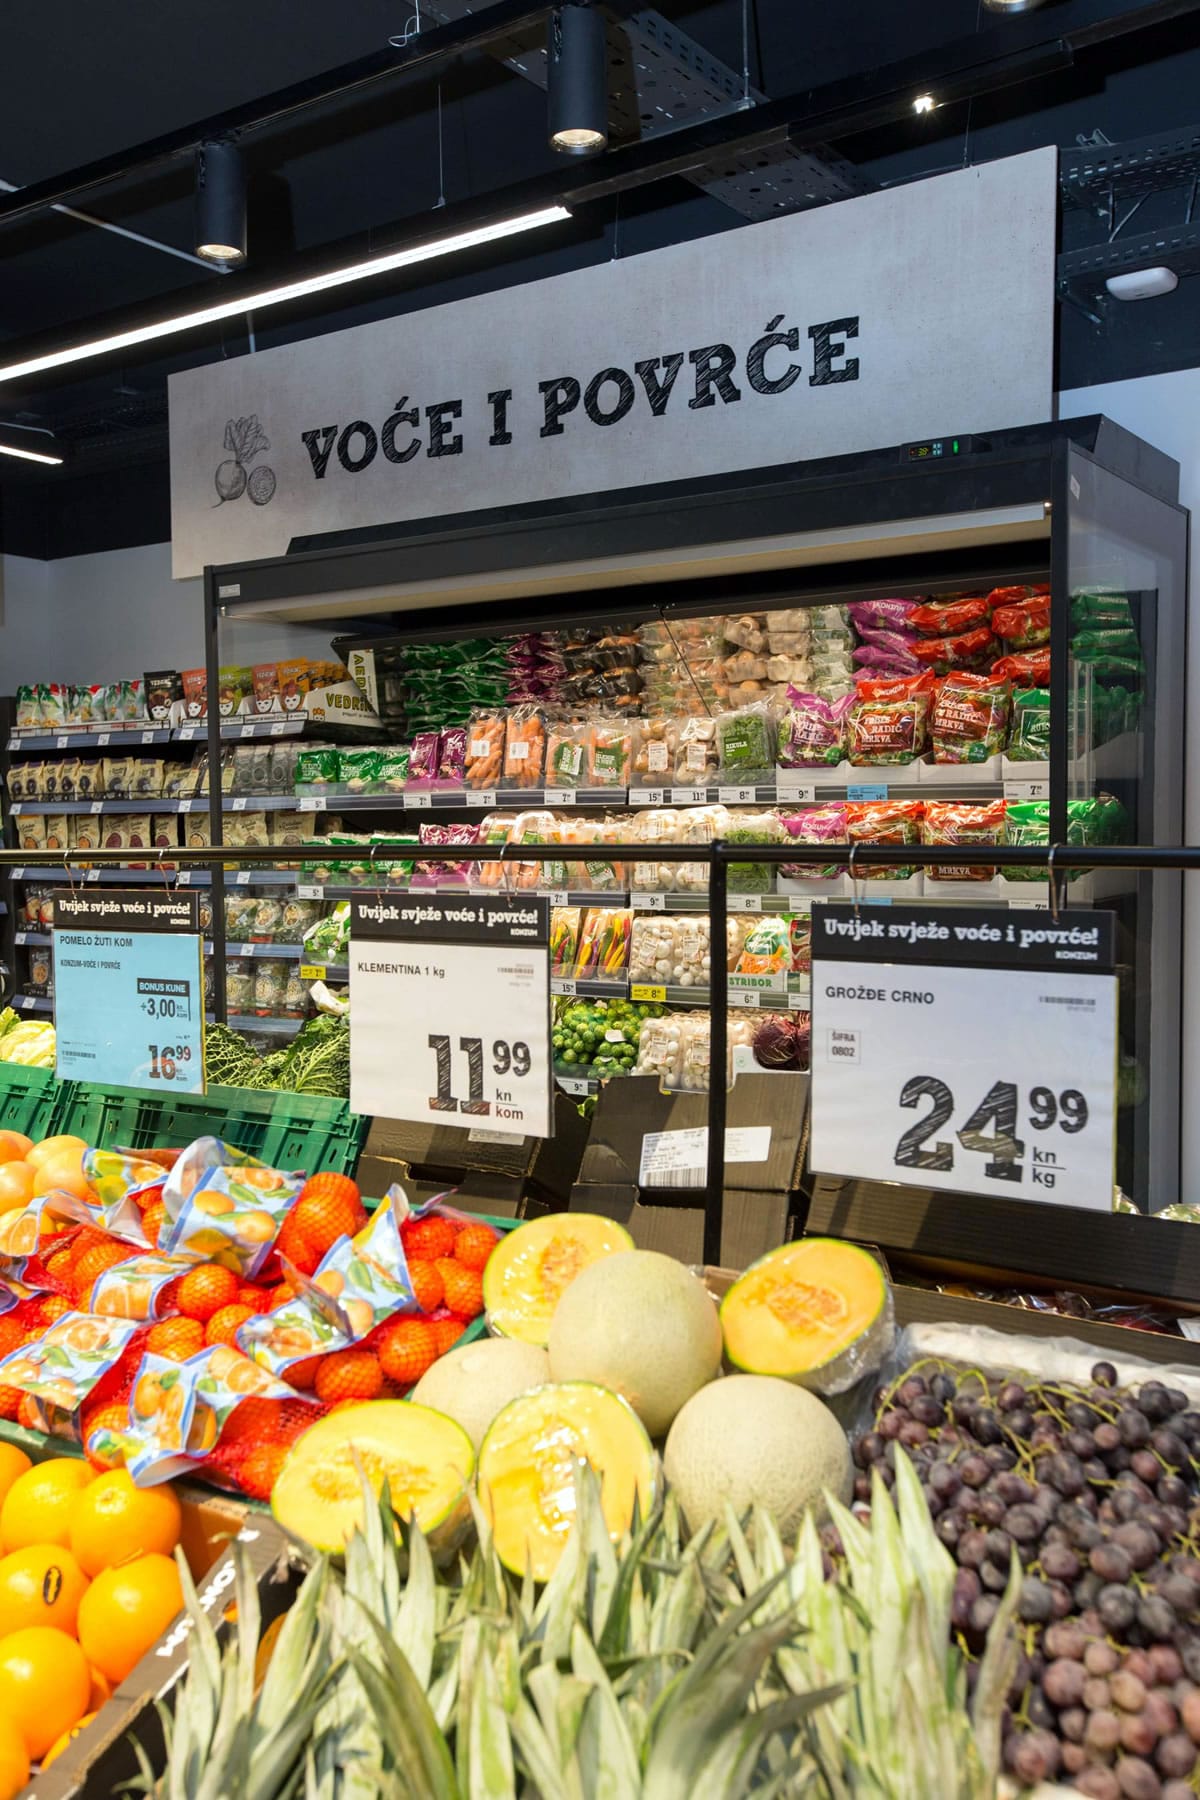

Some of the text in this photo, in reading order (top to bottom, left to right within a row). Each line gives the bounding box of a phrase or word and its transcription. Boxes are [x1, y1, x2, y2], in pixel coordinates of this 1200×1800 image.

[302, 314, 861, 480] VOĆE I POVRĆE
[935, 717, 965, 731] MRKVA
[861, 734, 892, 743] MRKVA
[938, 866, 971, 875] MRKVA
[59, 900, 191, 917] Uvijek svježe voće i povrće!
[358, 905, 538, 927] Uvijek svježe voće i povrće!
[60, 934, 133, 947] POMELO ŽUTI KOM
[510, 928, 538, 937] KONZUM
[823, 919, 1099, 948] Uvijek svježe voće i povrće!
[1055, 950, 1098, 961] KONZUM
[358, 961, 445, 979] KLEMENTINA 1 kg
[139, 982, 186, 993] BONUS KUNE
[729, 977, 772, 987] STRIBOR
[825, 985, 935, 1005] GROŽĐE CRNO
[831, 1030, 856, 1043] ŠIFRA
[148, 1044, 176, 1080] 16
[428, 1033, 532, 1116] 11 99
[495, 1088, 512, 1102] kn
[495, 1104, 524, 1120] kom
[894, 1075, 1089, 1183] 24 99
[1032, 1146, 1057, 1164] kn
[1032, 1168, 1056, 1188] kg
